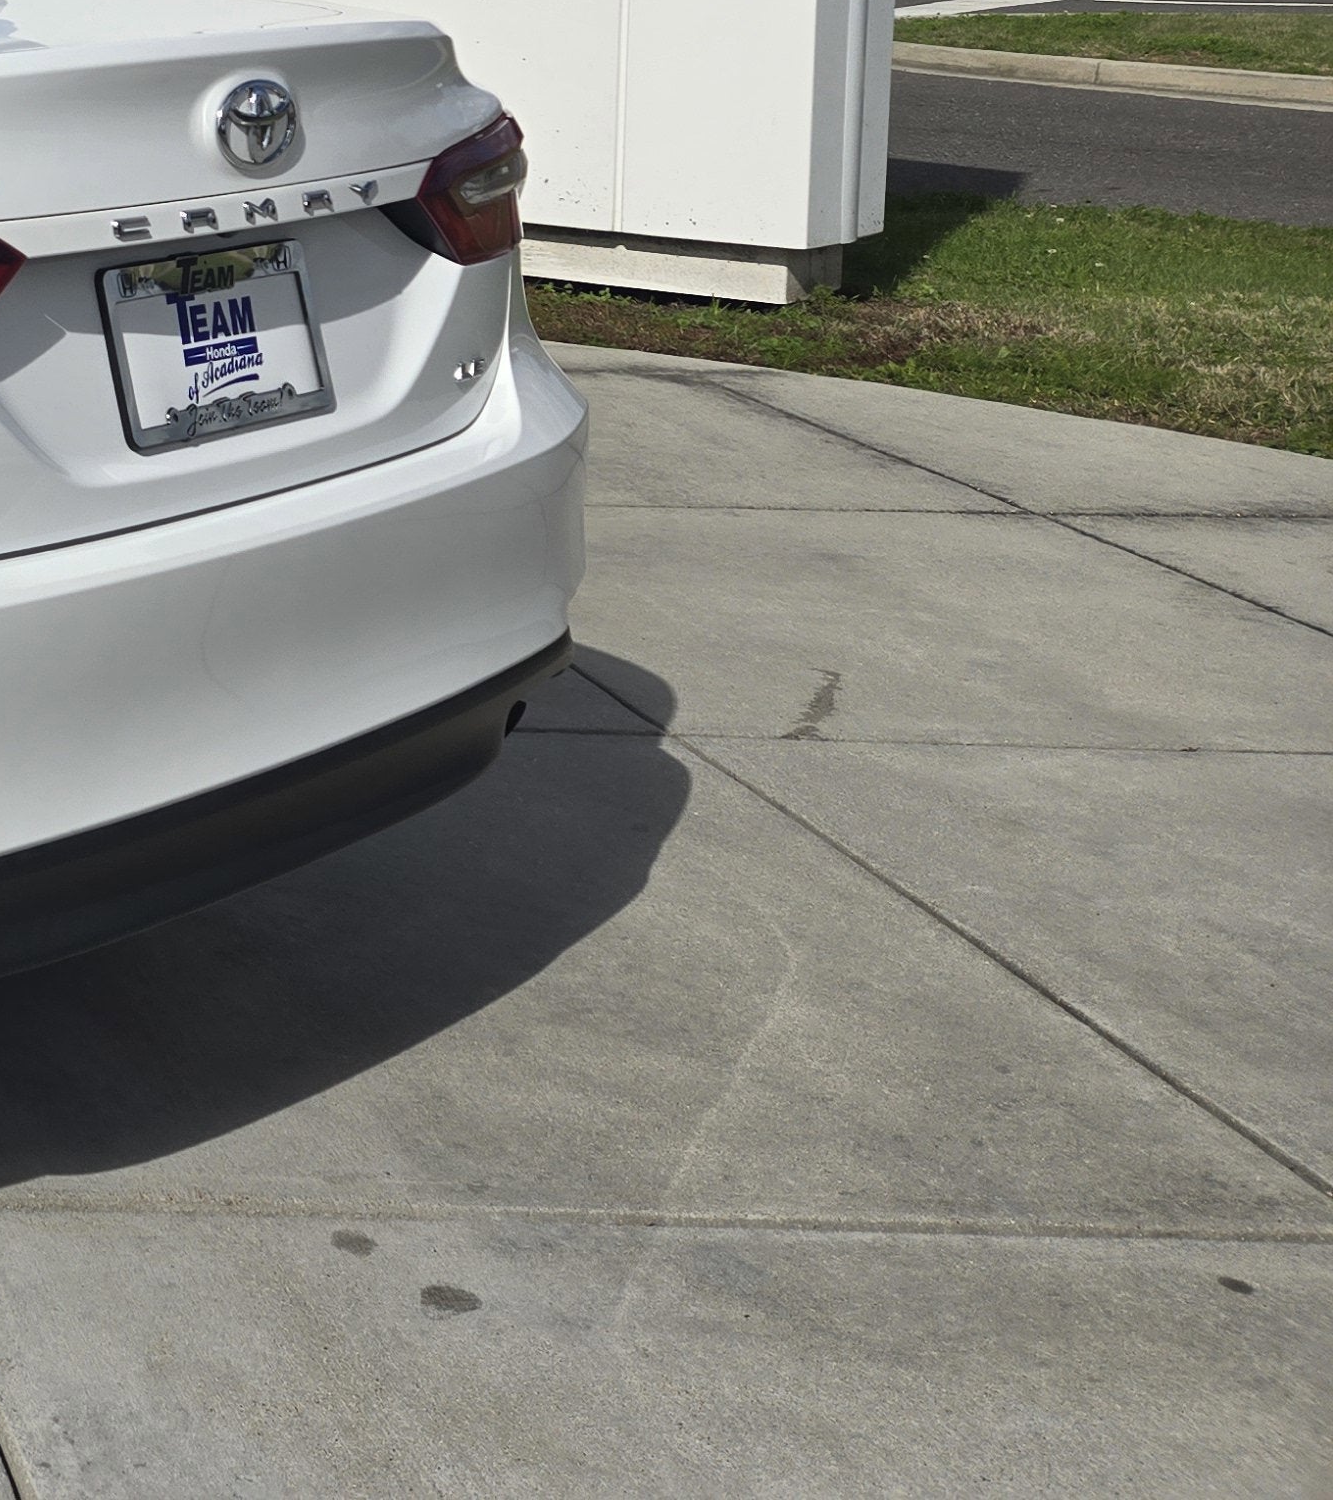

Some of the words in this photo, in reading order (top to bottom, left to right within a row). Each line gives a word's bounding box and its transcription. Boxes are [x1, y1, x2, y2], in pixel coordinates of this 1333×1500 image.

[110, 179, 379, 242] CAMRY
[175, 256, 235, 295] TEAM
[165, 292, 256, 345] TEAM
[188, 371, 201, 404] of
[201, 352, 264, 389] Acadiana
[205, 343, 237, 361] Honda
